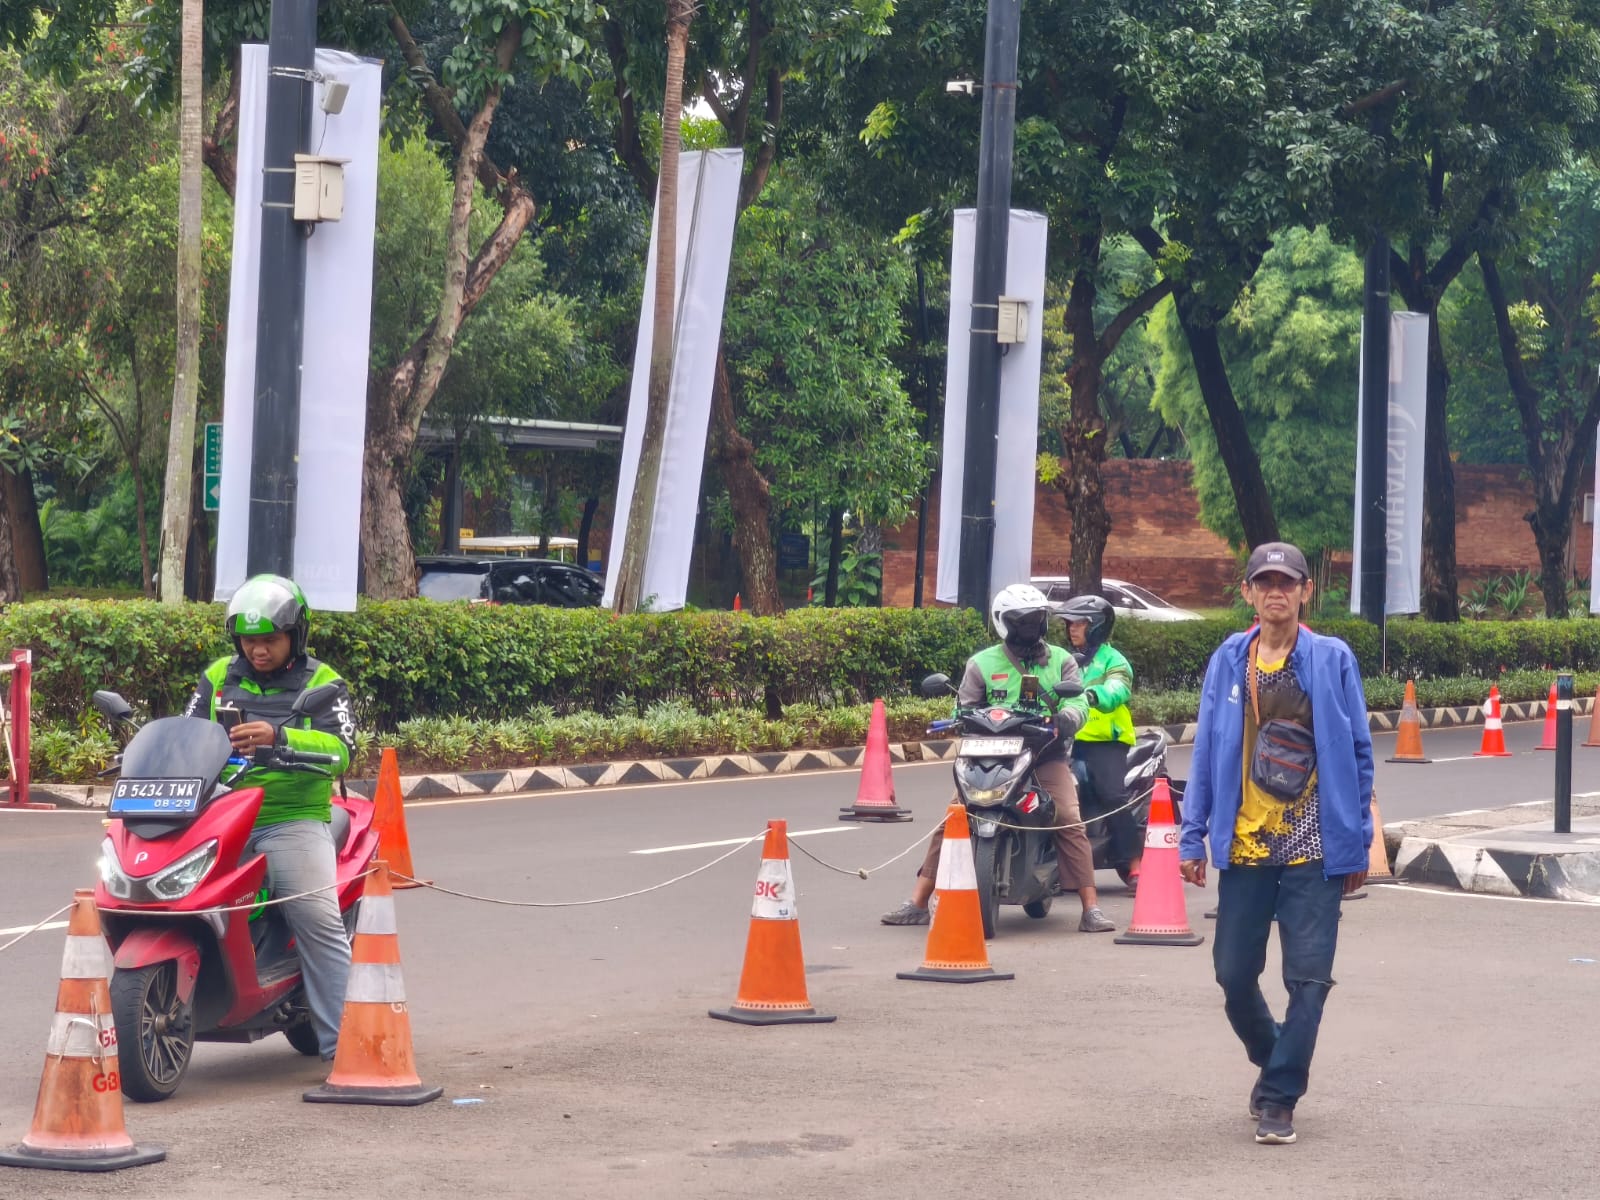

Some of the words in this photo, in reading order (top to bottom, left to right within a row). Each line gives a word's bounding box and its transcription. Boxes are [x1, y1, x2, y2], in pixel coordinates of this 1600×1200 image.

[117, 784, 127, 798] B
[130, 783, 163, 797] 5434
[169, 783, 195, 797] TWK
